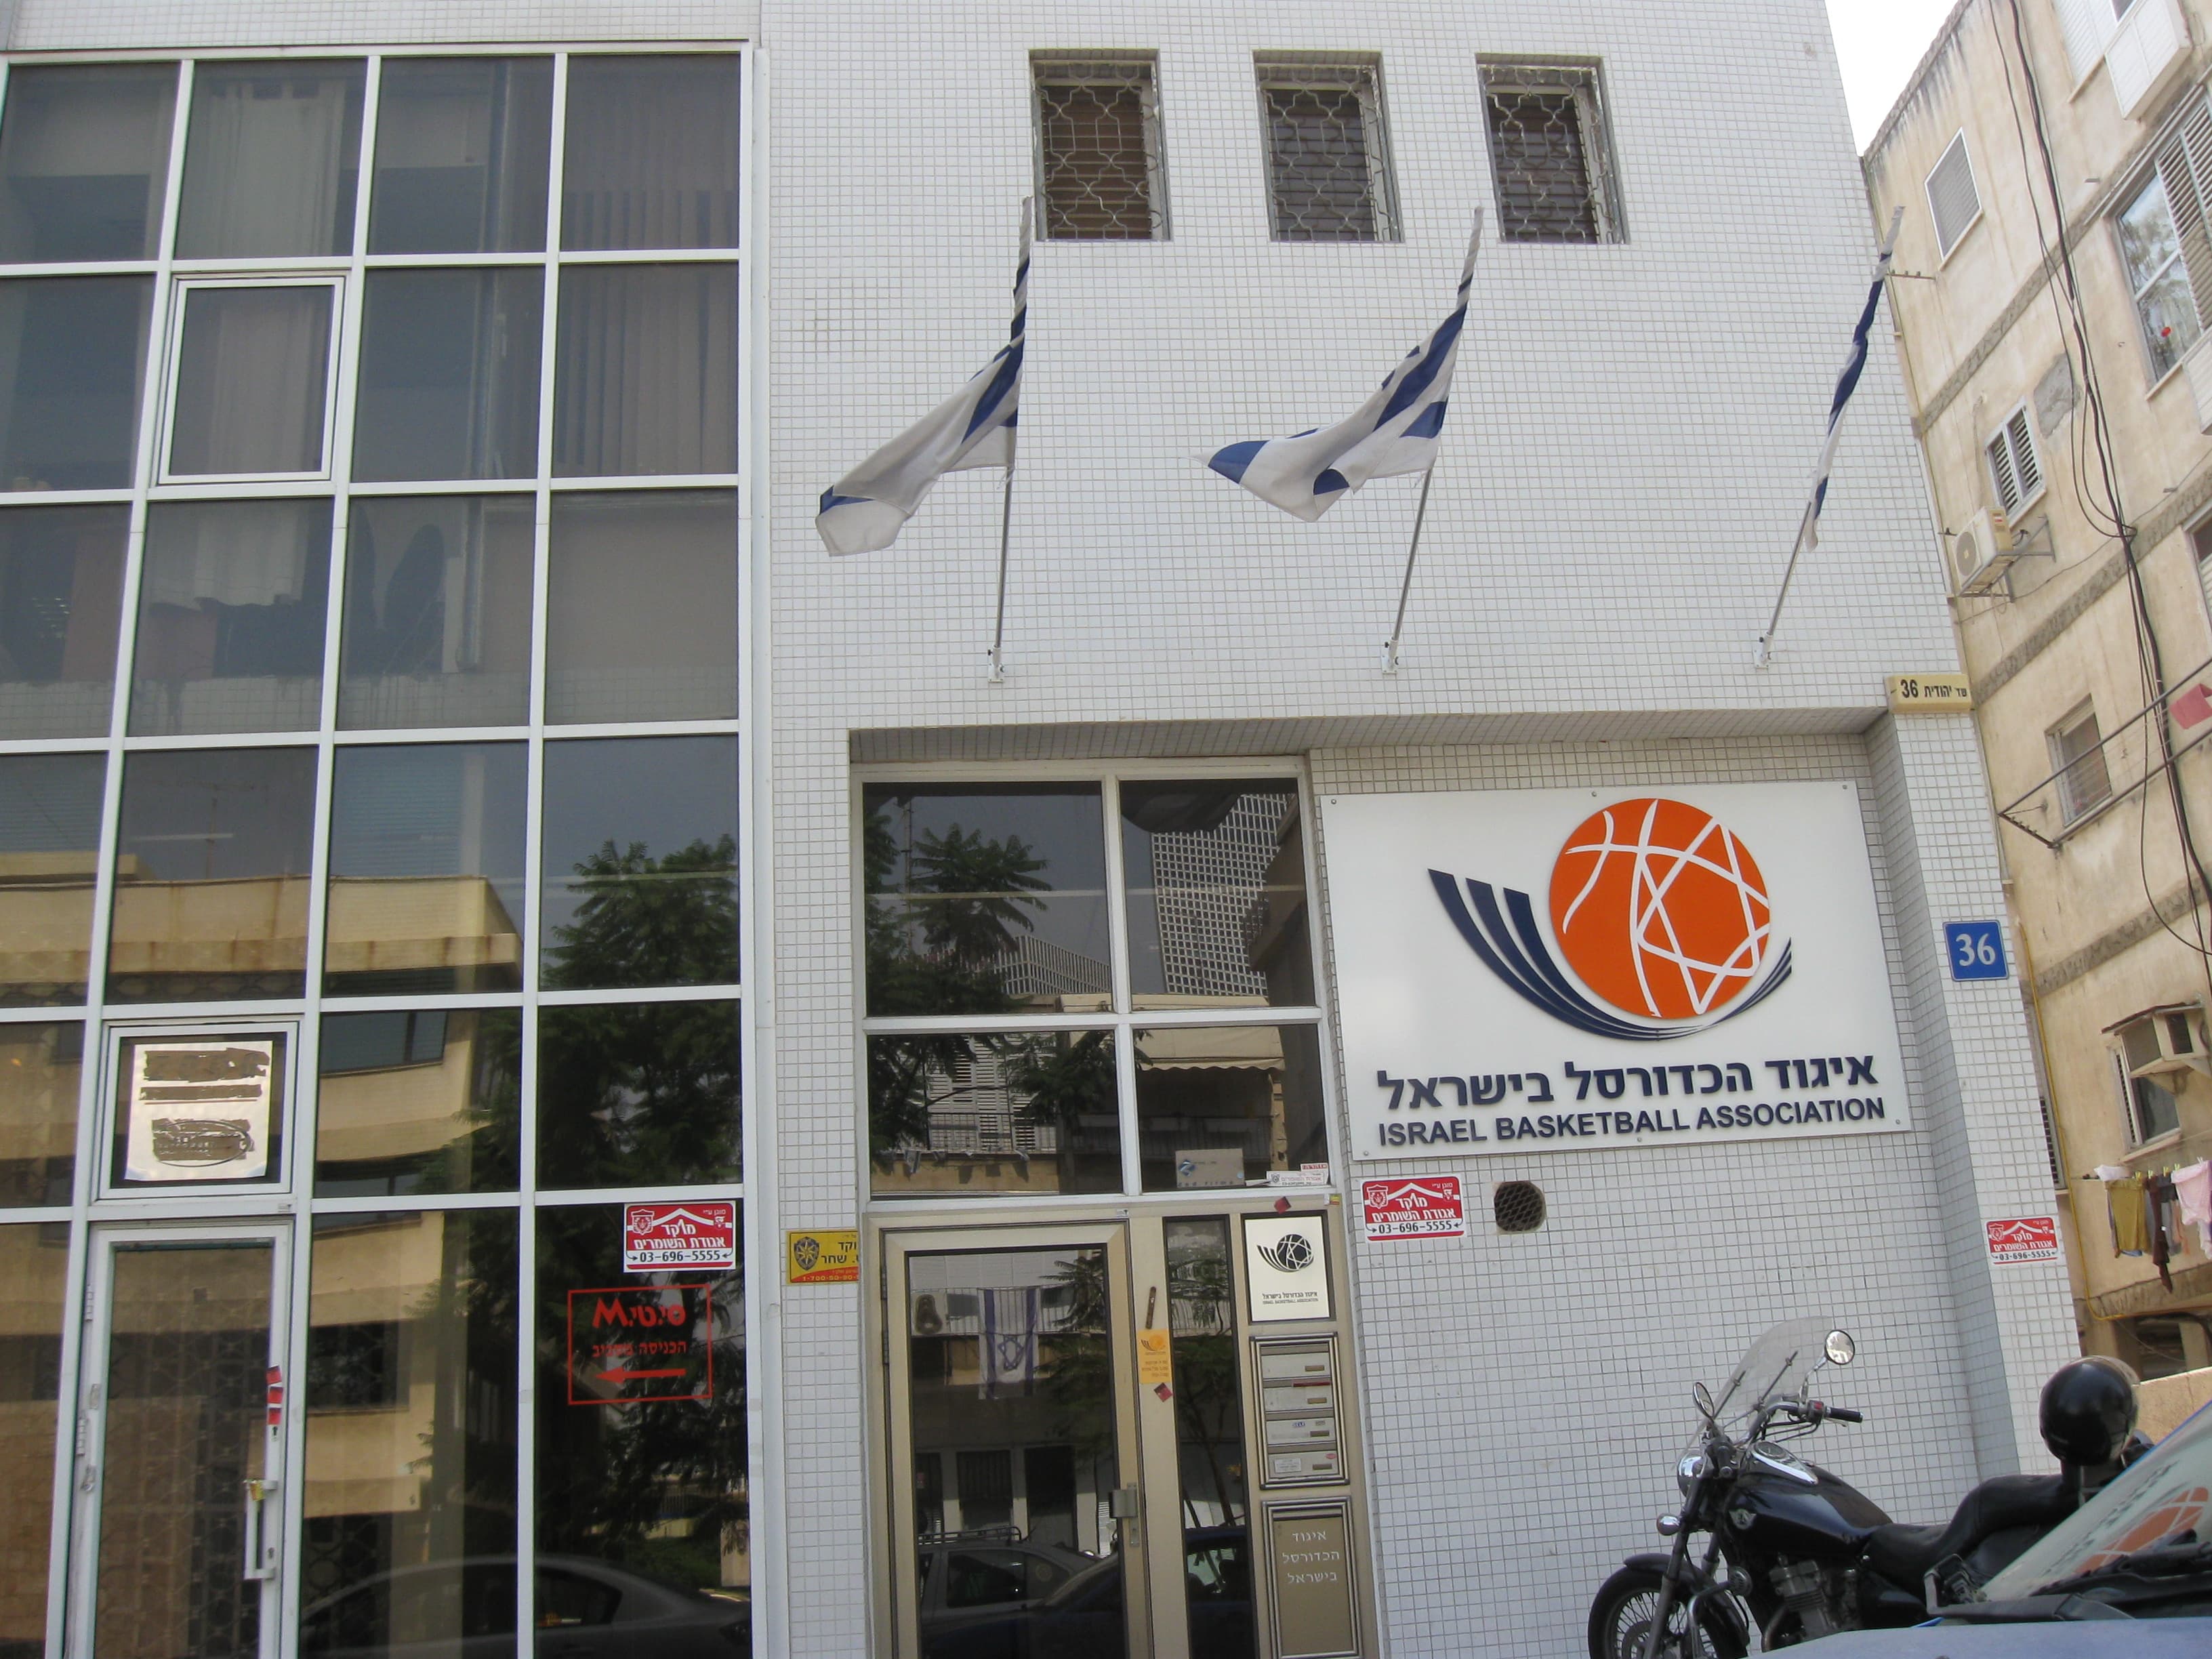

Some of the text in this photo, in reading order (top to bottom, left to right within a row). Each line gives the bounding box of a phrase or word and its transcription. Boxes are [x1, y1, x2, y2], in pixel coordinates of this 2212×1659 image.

[1900, 678, 1919, 699] 36
[1924, 684, 1952, 698] יהודית
[1956, 933, 1996, 966] 36
[1377, 1055, 1879, 1110] איגוד הכדורסל בישראל
[1379, 1097, 1886, 1147] ISRAEL BASKETBALL ASSOCIATION
[1395, 1193, 1429, 1210] מוקד
[1371, 1208, 1456, 1223] אגודת השומרים
[661, 1218, 697, 1237] מוקד
[1378, 1221, 1452, 1234] 03-696-5555
[2010, 1230, 2033, 1242] מוקד
[633, 1237, 726, 1250] אגודת השומרים
[838, 1242, 857, 1252] וקד
[1993, 1240, 2053, 1252] אגודת השומרים
[639, 1250, 720, 1263] 03-696-5555
[821, 1255, 846, 1263] שחר
[1999, 1250, 2051, 1261] 03-696-5555
[639, 1340, 687, 1355] הכניסה
[1292, 1531, 1326, 1542] איגוד
[1282, 1551, 1339, 1563] הכדורסל
[1288, 1572, 1337, 1584] בישראל
